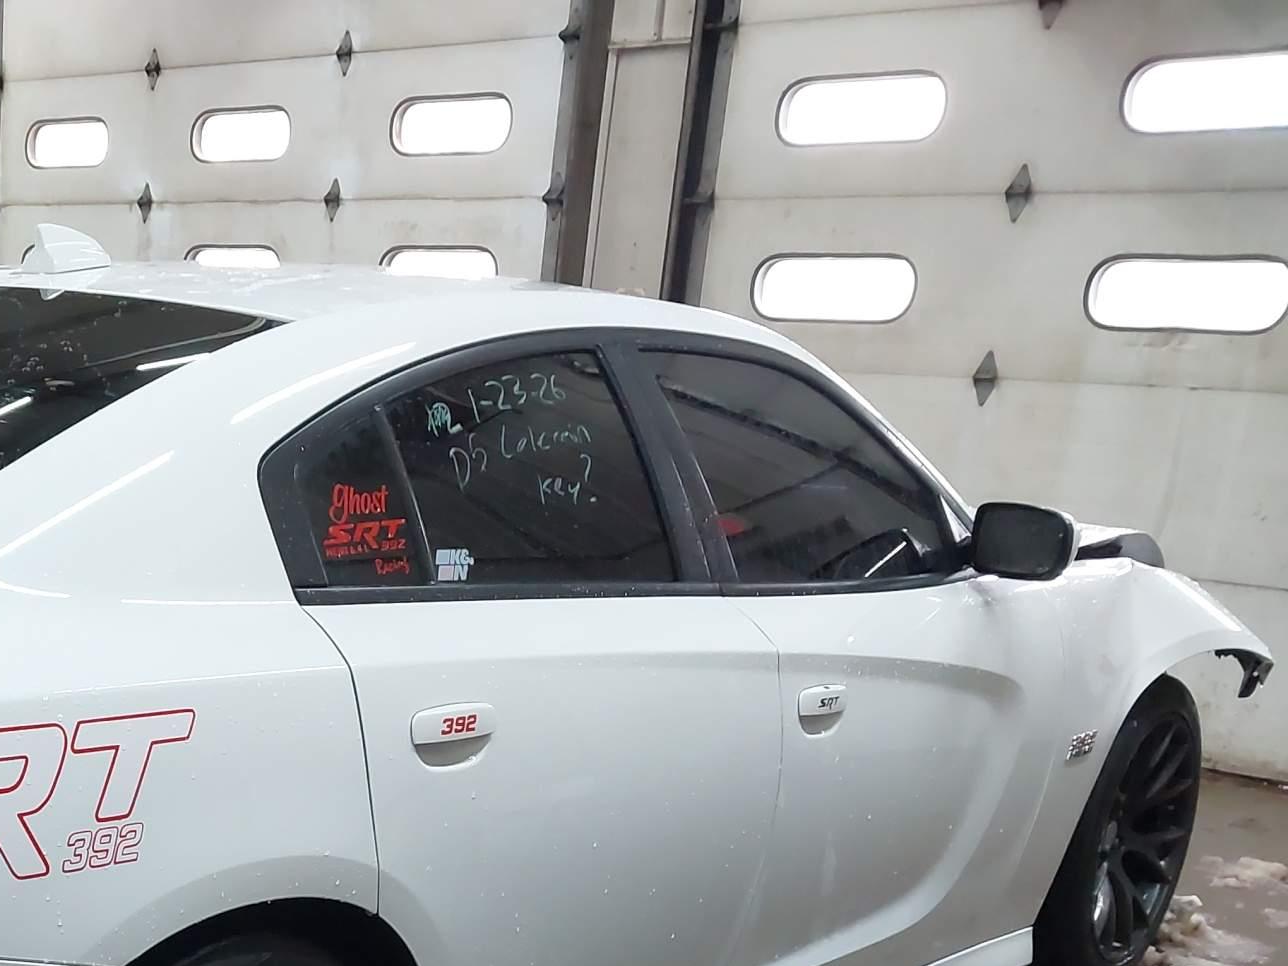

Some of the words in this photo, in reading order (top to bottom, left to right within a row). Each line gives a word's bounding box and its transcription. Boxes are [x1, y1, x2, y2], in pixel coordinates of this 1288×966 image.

[468, 373, 566, 424] 1-23-26
[328, 483, 388, 524] ghost
[323, 518, 407, 550] SRT
[817, 695, 841, 711] SRT
[440, 713, 478, 736] 392
[62, 822, 143, 874] 392
